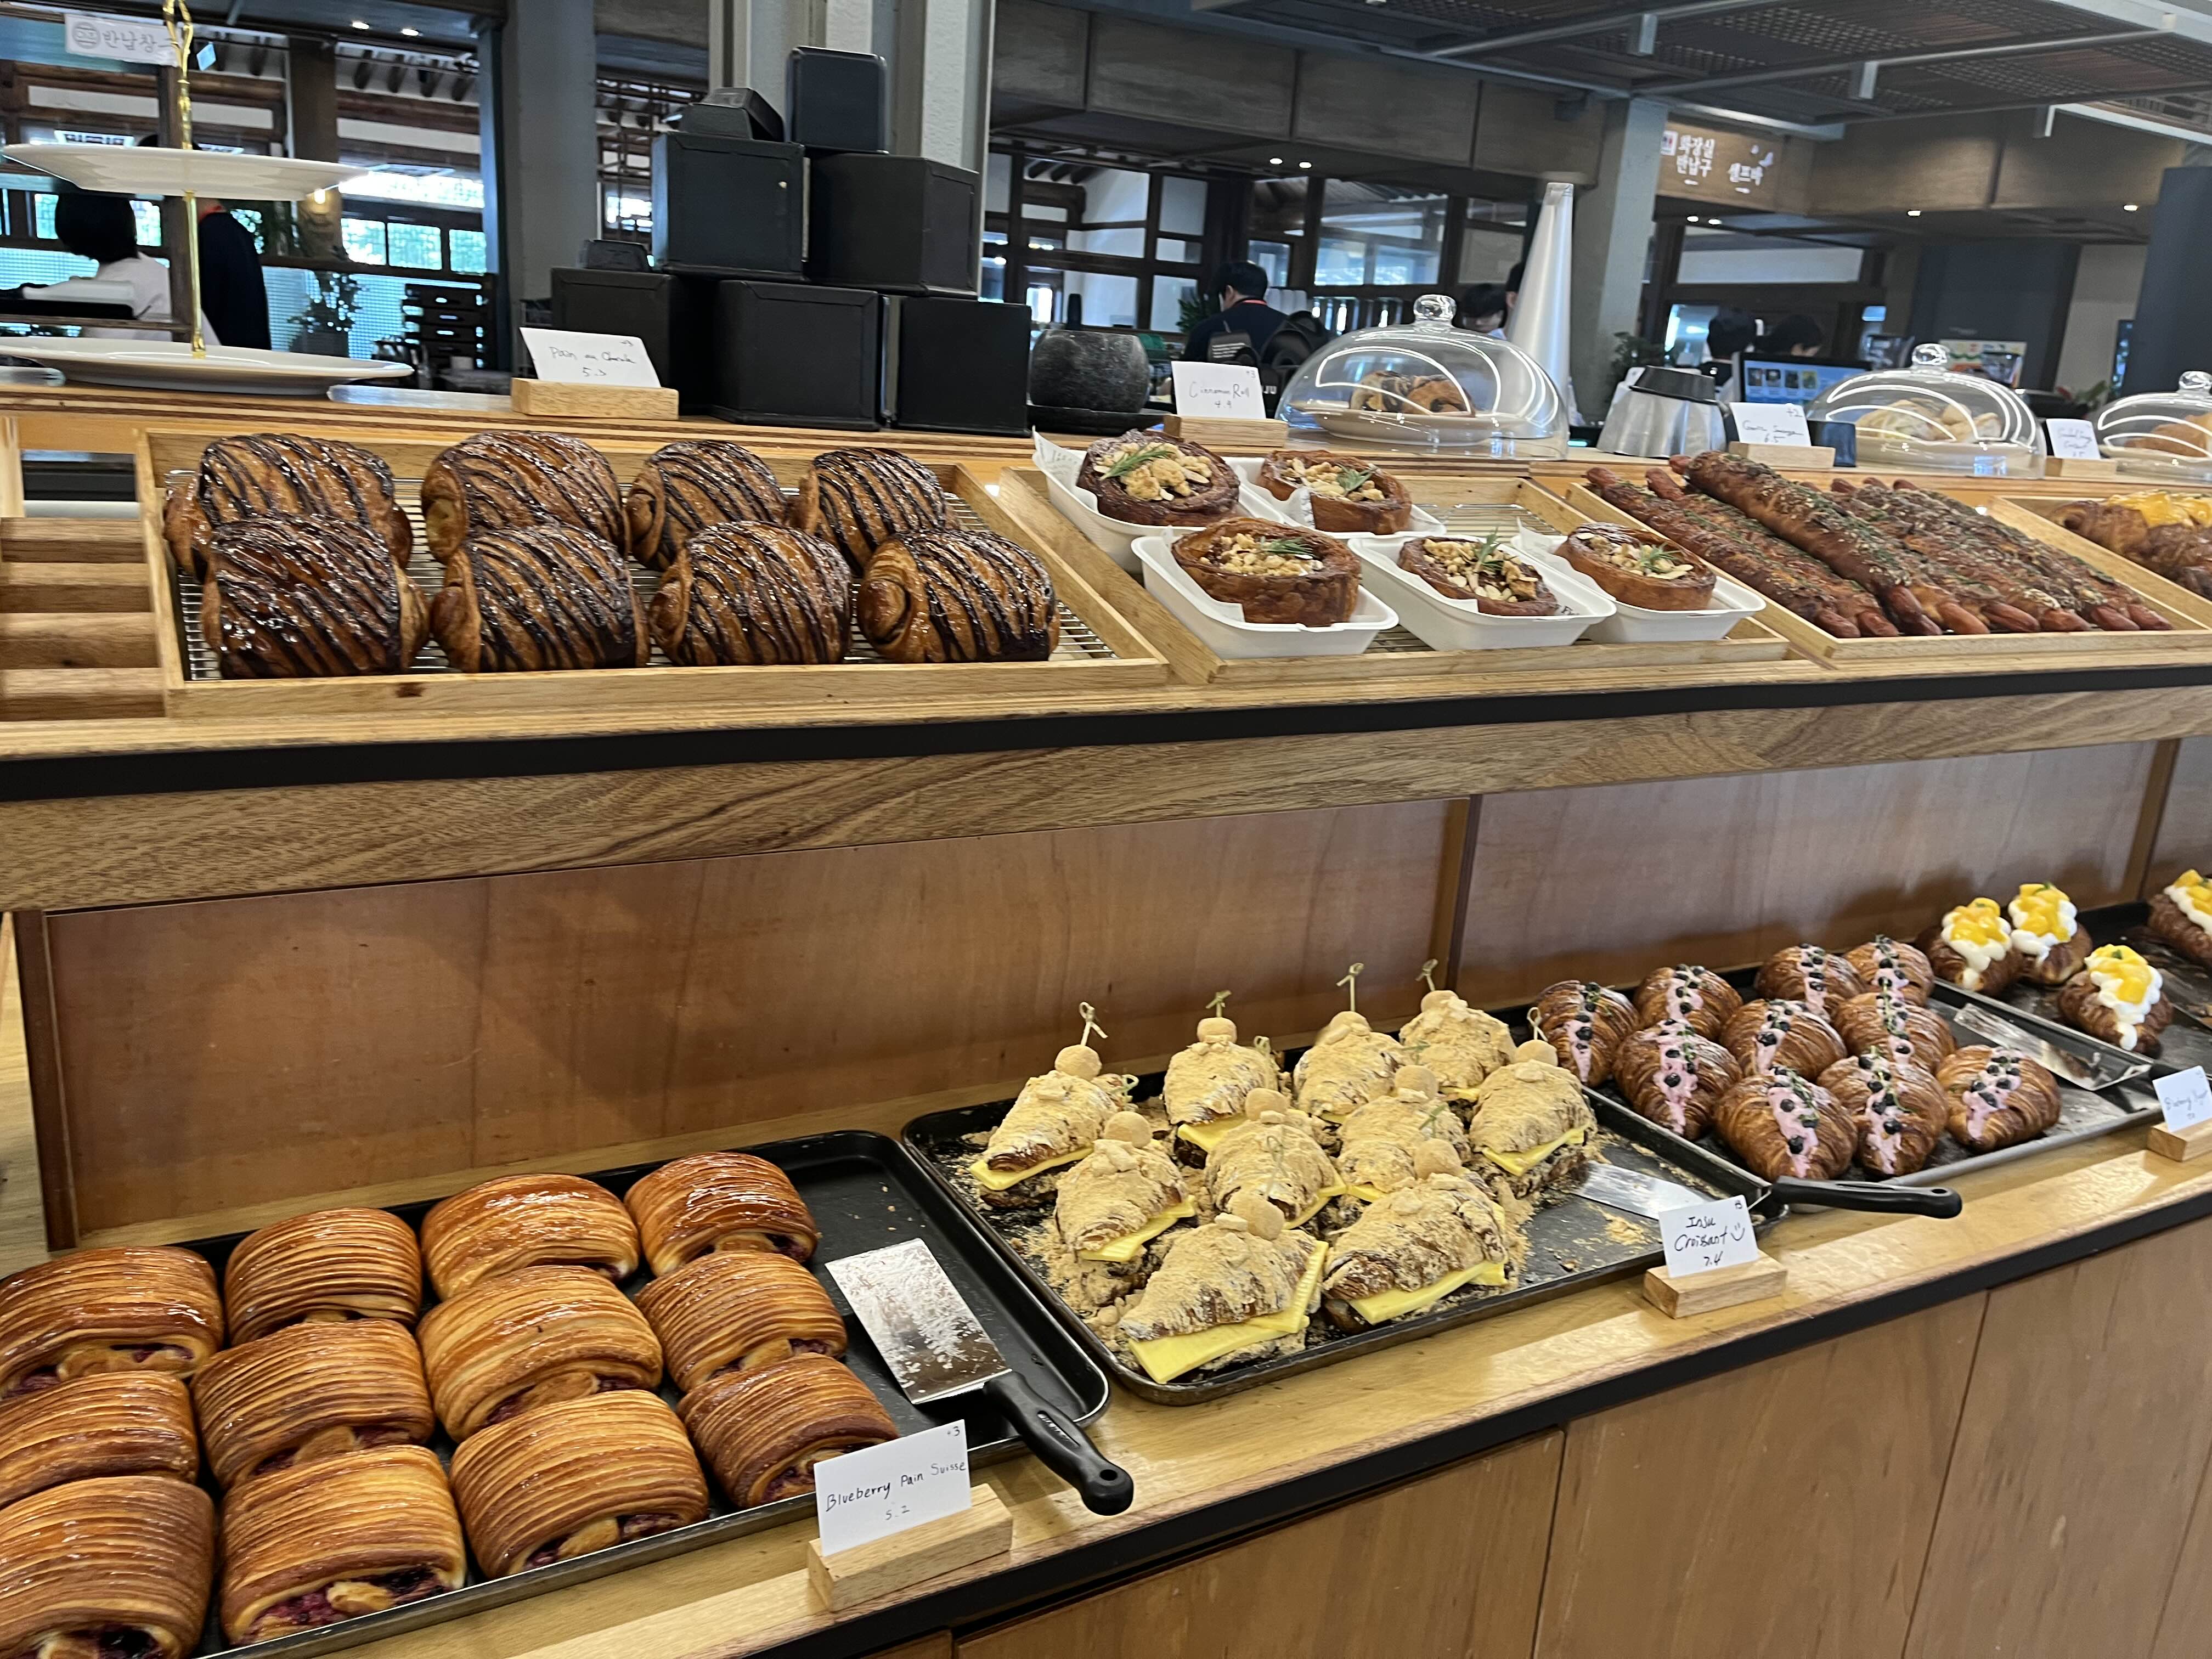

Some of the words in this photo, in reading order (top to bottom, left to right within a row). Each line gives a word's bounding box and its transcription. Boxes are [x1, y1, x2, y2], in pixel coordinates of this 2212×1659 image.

[102, 30, 172, 54] 반납창
[826, 1482, 891, 1512] Blueberry
[900, 1472, 924, 1487] Pain
[930, 1461, 967, 1476] Suisse
